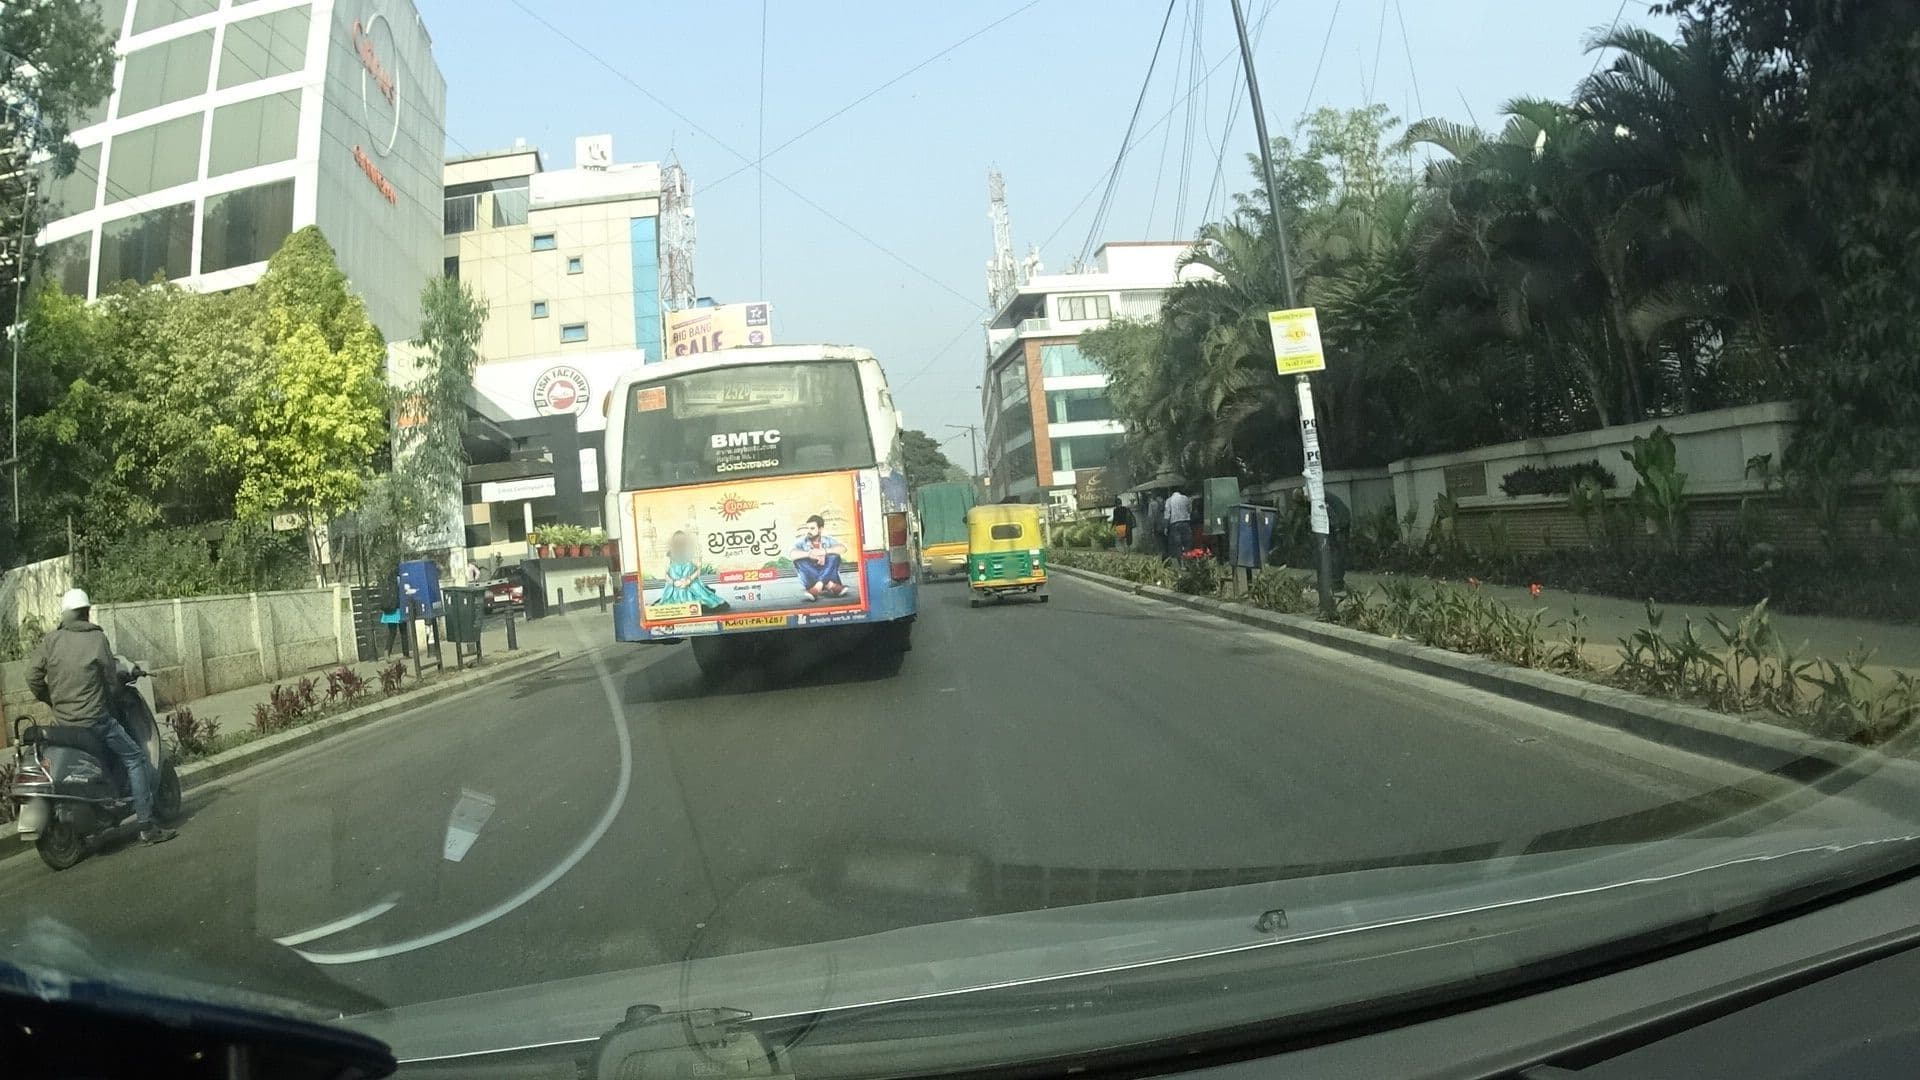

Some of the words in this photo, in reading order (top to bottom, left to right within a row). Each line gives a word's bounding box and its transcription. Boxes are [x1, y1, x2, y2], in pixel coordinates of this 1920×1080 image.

[673, 329, 687, 343] BIG
[688, 322, 712, 338] BANG
[536, 376, 551, 397] FISH
[552, 369, 587, 392] FACTORY
[711, 429, 781, 449] BMTC
[743, 571, 759, 581] 22
[748, 592, 755, 601] 8
